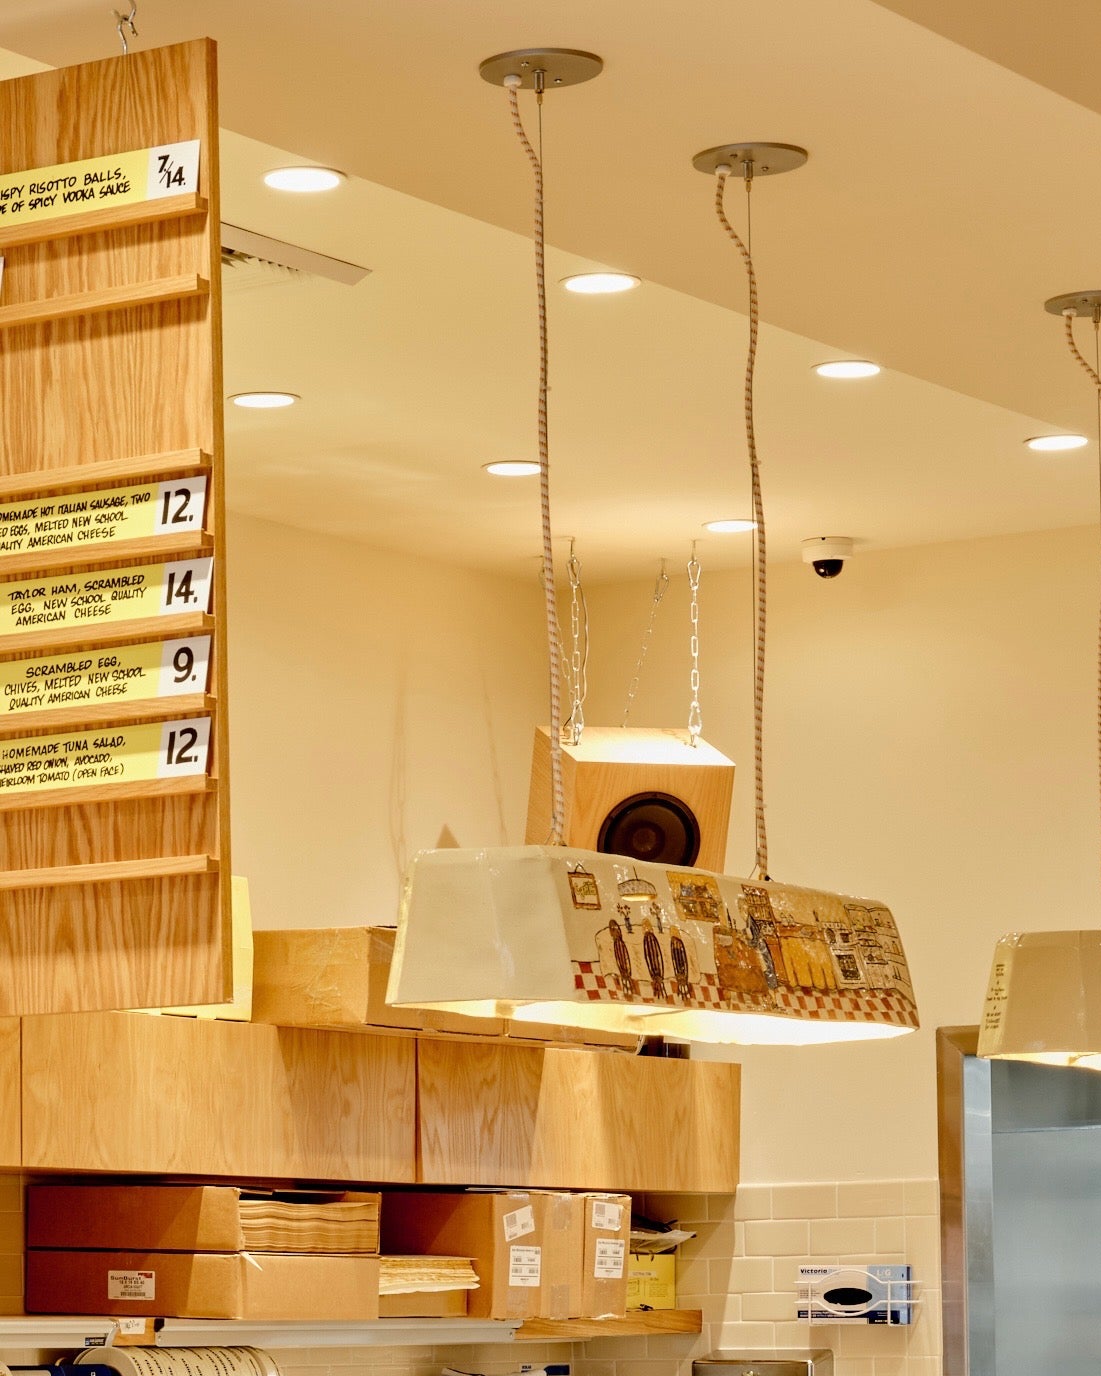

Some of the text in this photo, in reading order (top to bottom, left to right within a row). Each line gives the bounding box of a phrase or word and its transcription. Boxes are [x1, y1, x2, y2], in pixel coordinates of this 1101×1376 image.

[29, 176, 77, 195] RISOTTO
[84, 168, 127, 184] BALLS,
[11, 201, 24, 212] OF
[28, 195, 57, 211] SPICY
[63, 188, 95, 203] VODKA
[100, 181, 131, 199] SAUCE
[40, 505, 55, 519] HOT
[57, 500, 88, 514] ITALIAN
[90, 495, 128, 510] SAUSAGE,
[131, 492, 151, 505] TWO
[161, 488, 194, 525] 12.
[10, 523, 30, 536] EGGS,
[35, 518, 69, 533] MELTED
[72, 515, 91, 528] NEW
[95, 511, 128, 524] SCHOOL
[27, 532, 73, 549] AMERICAN
[77, 526, 117, 540] CHEESE
[8, 574, 145, 601] TAYLOR HAM, SCRAMBLED
[11, 586, 148, 615] EGG, NEW SCHOOL QUALITY
[165, 570, 198, 606] 14.
[15, 604, 112, 627] AMERICAN CHEESE
[26, 656, 122, 679] SCRAMBLED EGG,
[172, 646, 197, 683] 9.
[4, 667, 147, 696] CHIVES, MELTED NEW SCHOOL
[8, 683, 128, 712] QUALITY AMERICAN CHEESE
[2, 735, 127, 760] HOMEMADE TUNA SALAD,
[166, 727, 199, 765] 12.
[26, 758, 42, 771] RED
[43, 755, 70, 770] ONION,
[74, 753, 113, 766] AVOCADO,
[37, 771, 70, 784] TOMATO
[72, 768, 97, 781] (OPEN
[100, 763, 125, 777] FACE)
